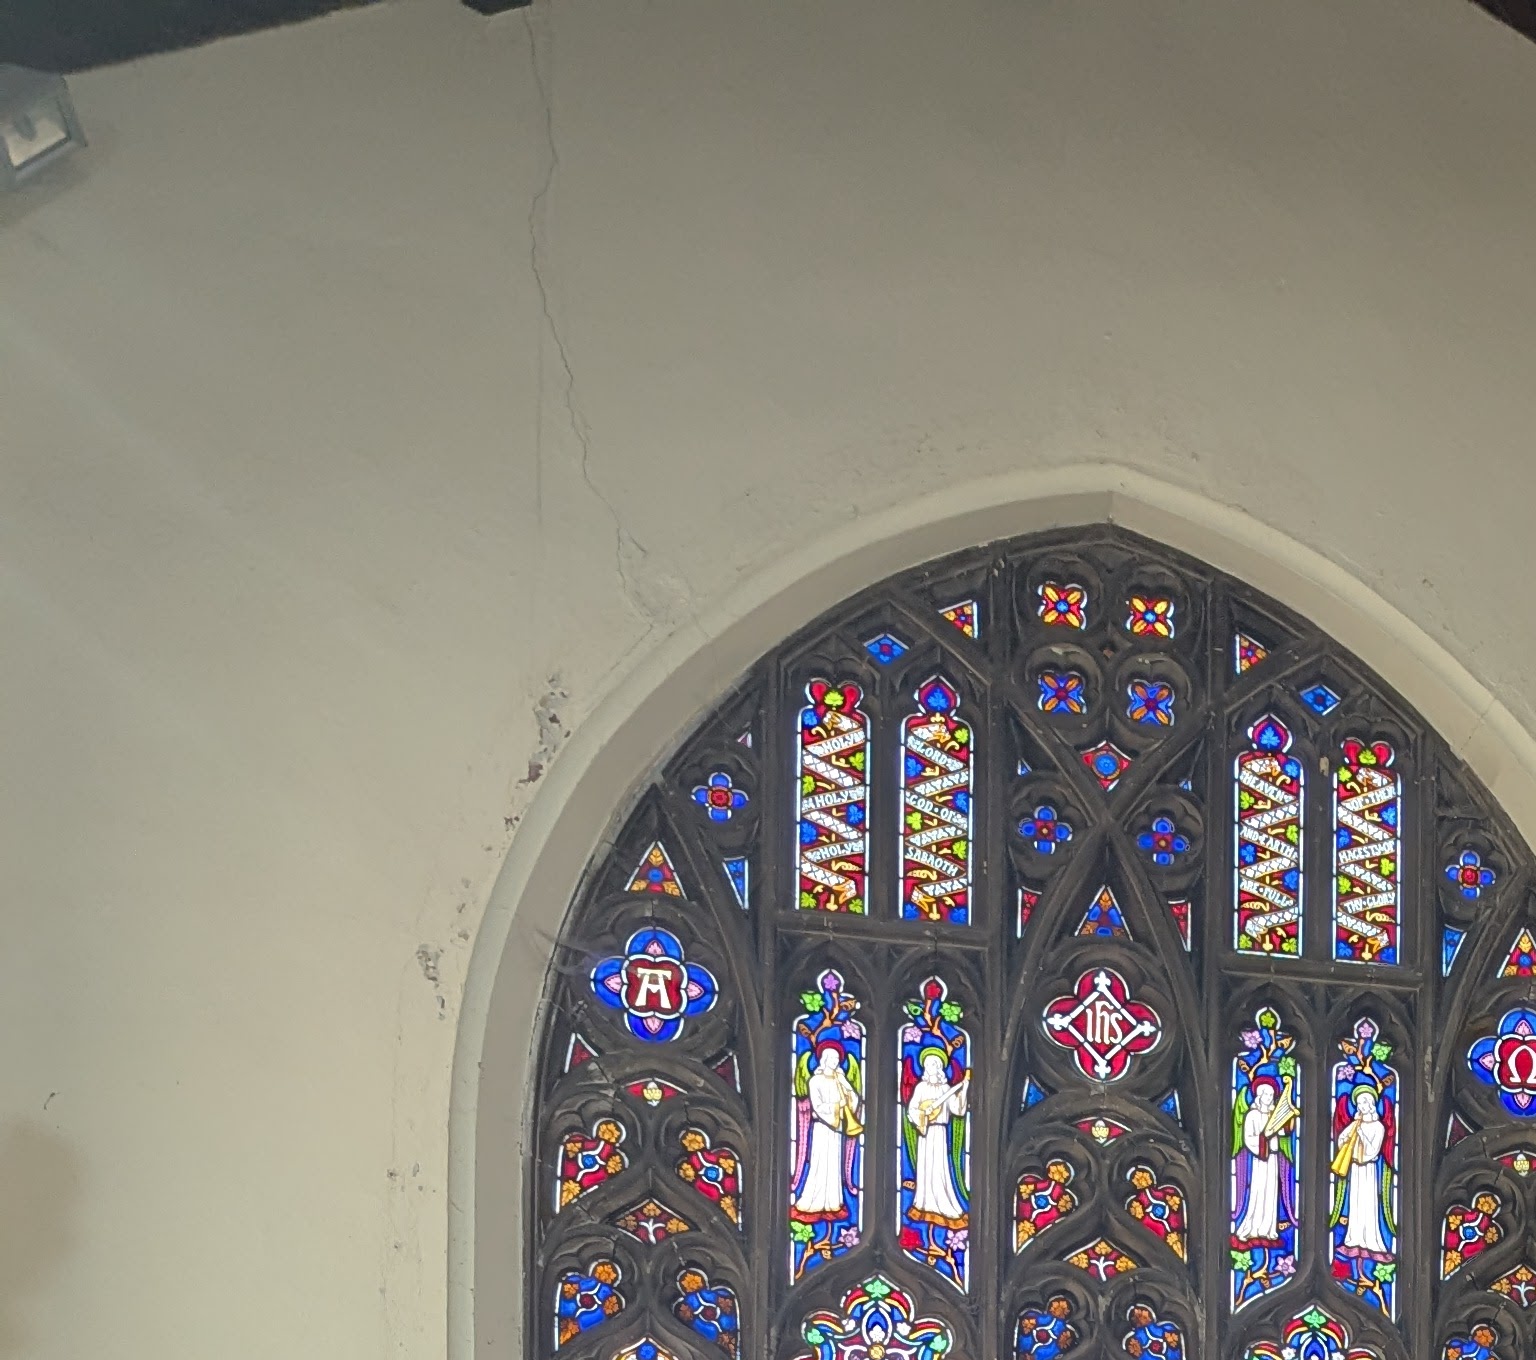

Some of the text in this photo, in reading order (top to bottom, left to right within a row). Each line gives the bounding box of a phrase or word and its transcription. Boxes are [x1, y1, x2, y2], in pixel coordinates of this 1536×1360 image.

[824, 732, 854, 753] HOLY
[918, 742, 948, 766] LORD
[815, 790, 850, 810] HOLY
[820, 844, 851, 861] HOLY
[906, 846, 958, 876] SABAOTH
